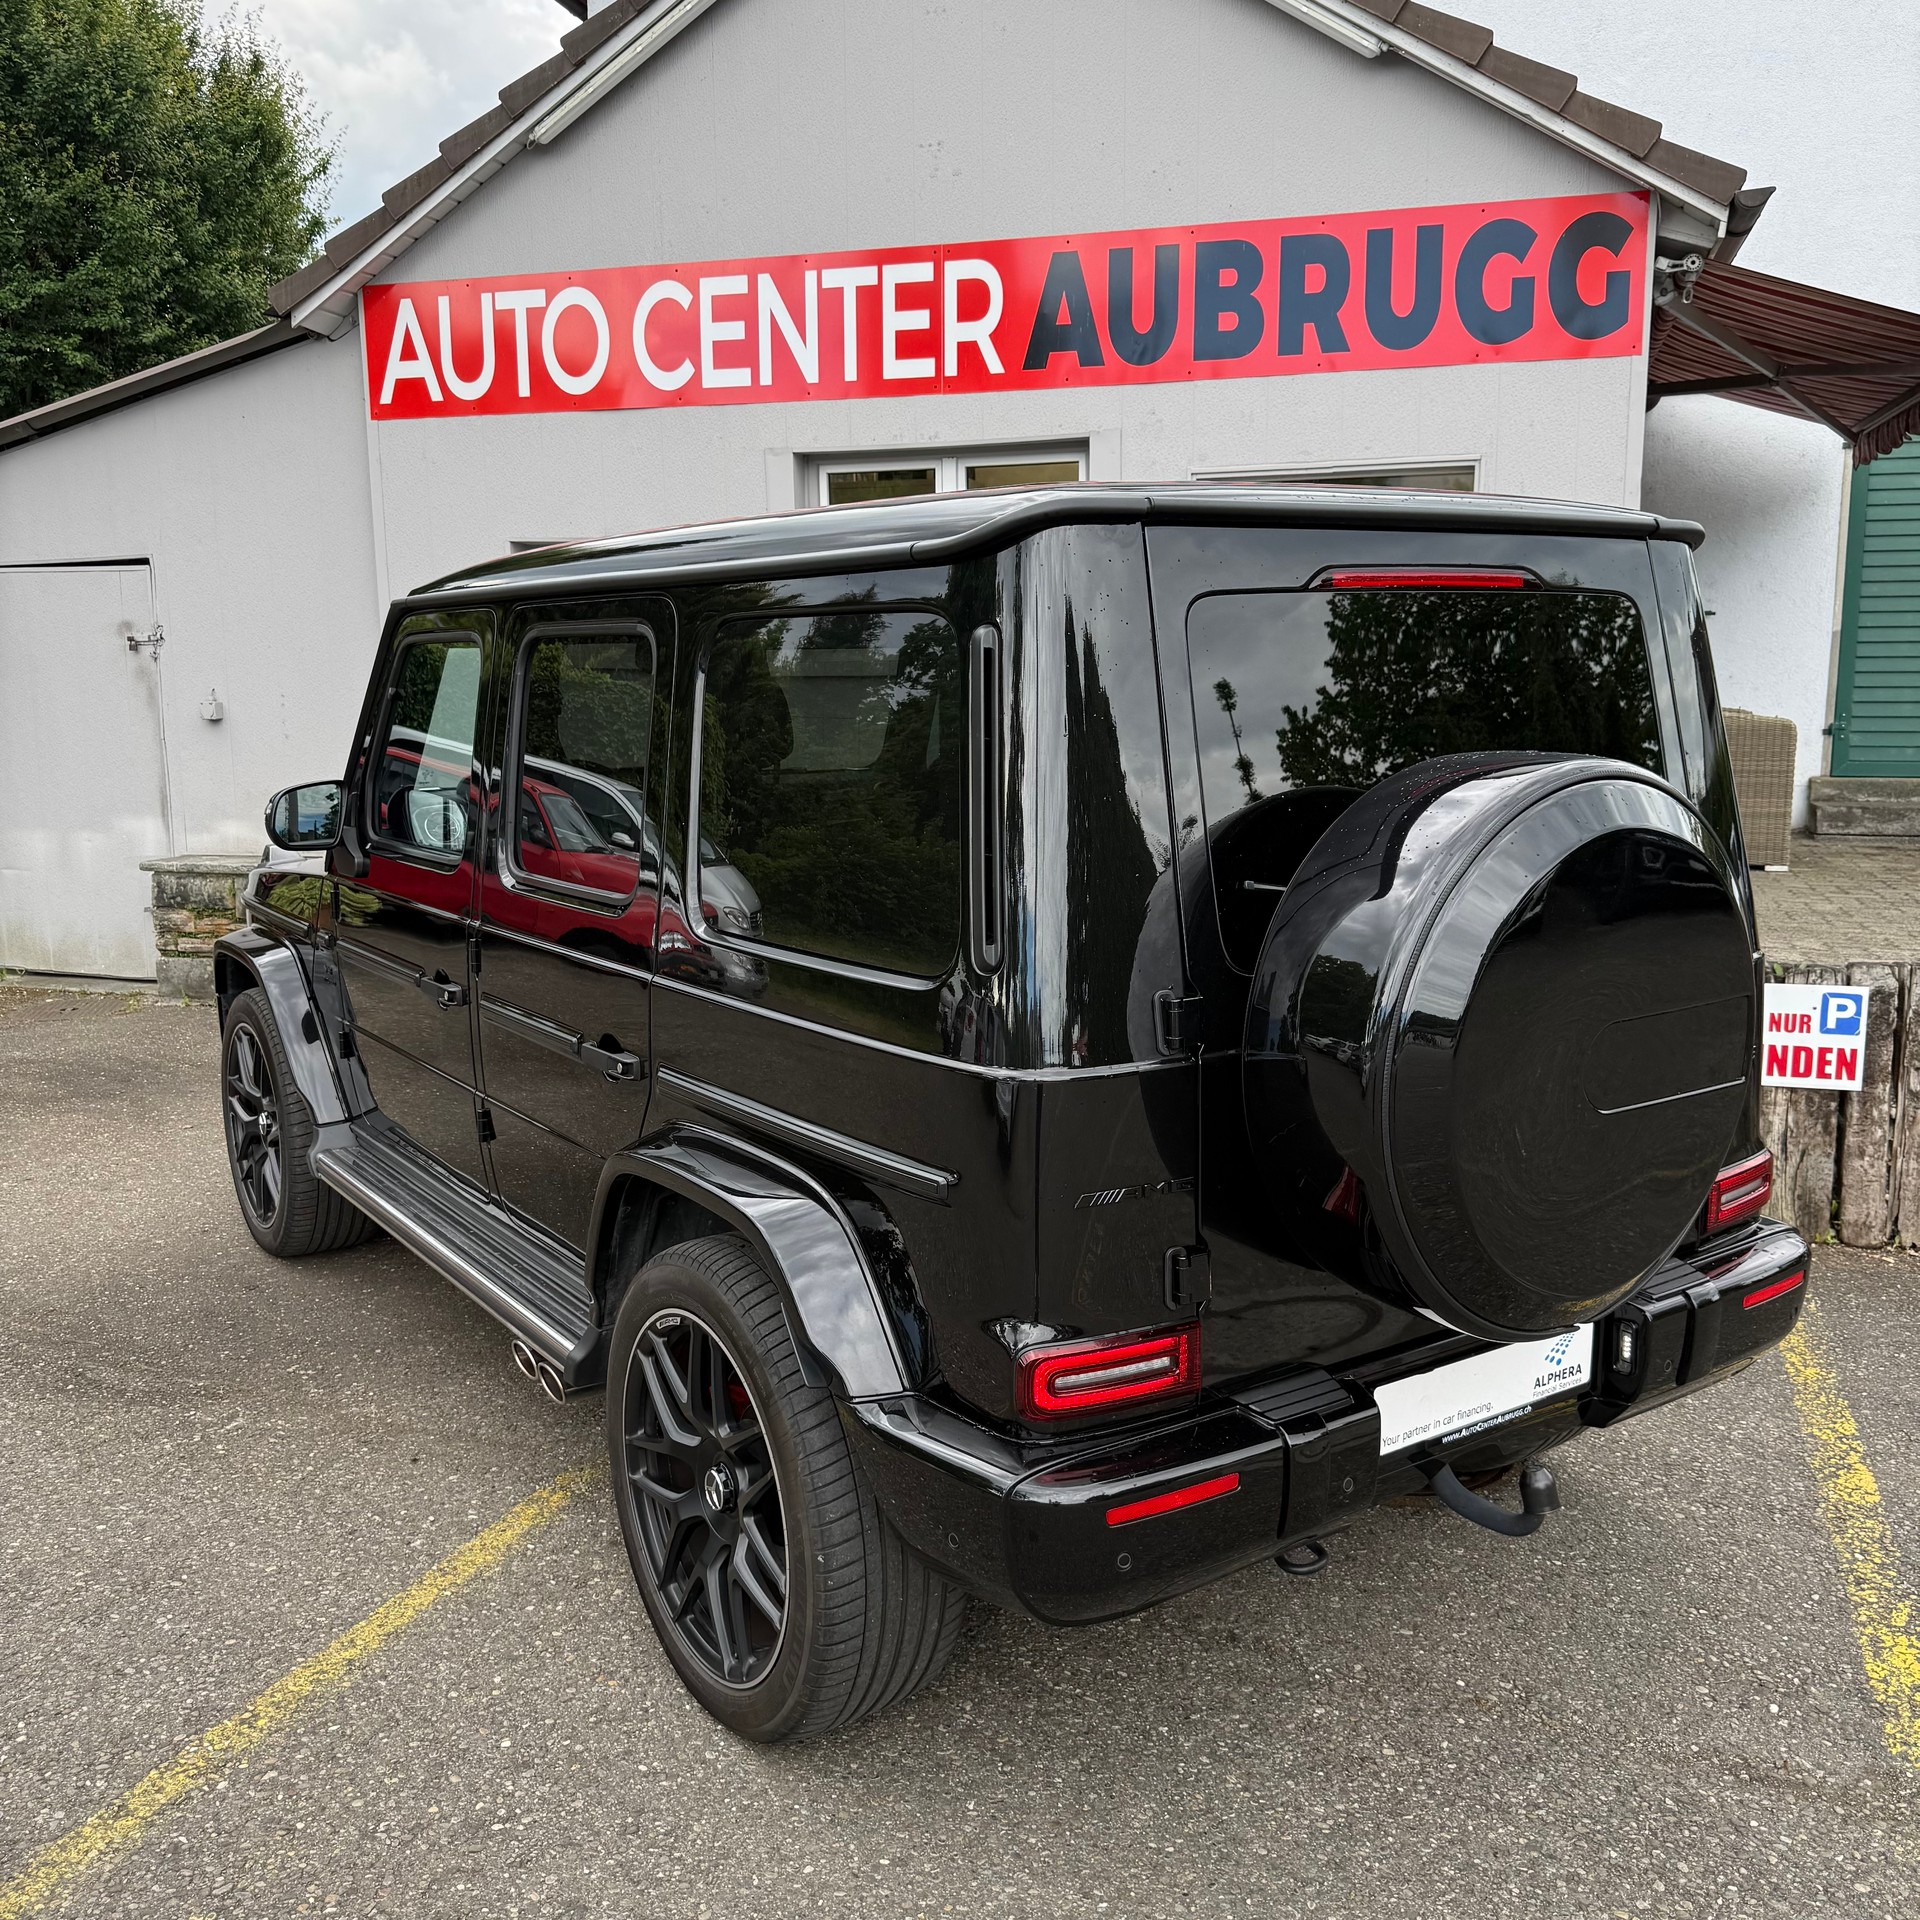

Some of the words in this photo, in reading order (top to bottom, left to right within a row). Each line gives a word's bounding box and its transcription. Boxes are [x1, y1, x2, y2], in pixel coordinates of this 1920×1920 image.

[379, 286, 611, 405] AUTO
[632, 258, 1005, 391] CENTER
[1022, 211, 1635, 370] AUBRUGG
[1768, 1012, 1812, 1034] NUR
[1826, 997, 1857, 1030] P
[1762, 1044, 1858, 1081] NDEN
[1532, 1384, 1558, 1399] Financial
[1558, 1377, 1582, 1390] Services
[1533, 1363, 1582, 1390] ALPHERA
[1382, 1435, 1401, 1448] Your
[1402, 1423, 1431, 1443] partner
[1433, 1419, 1441, 1430] in
[1442, 1414, 1456, 1426] car
[1457, 1401, 1494, 1420] financing.
